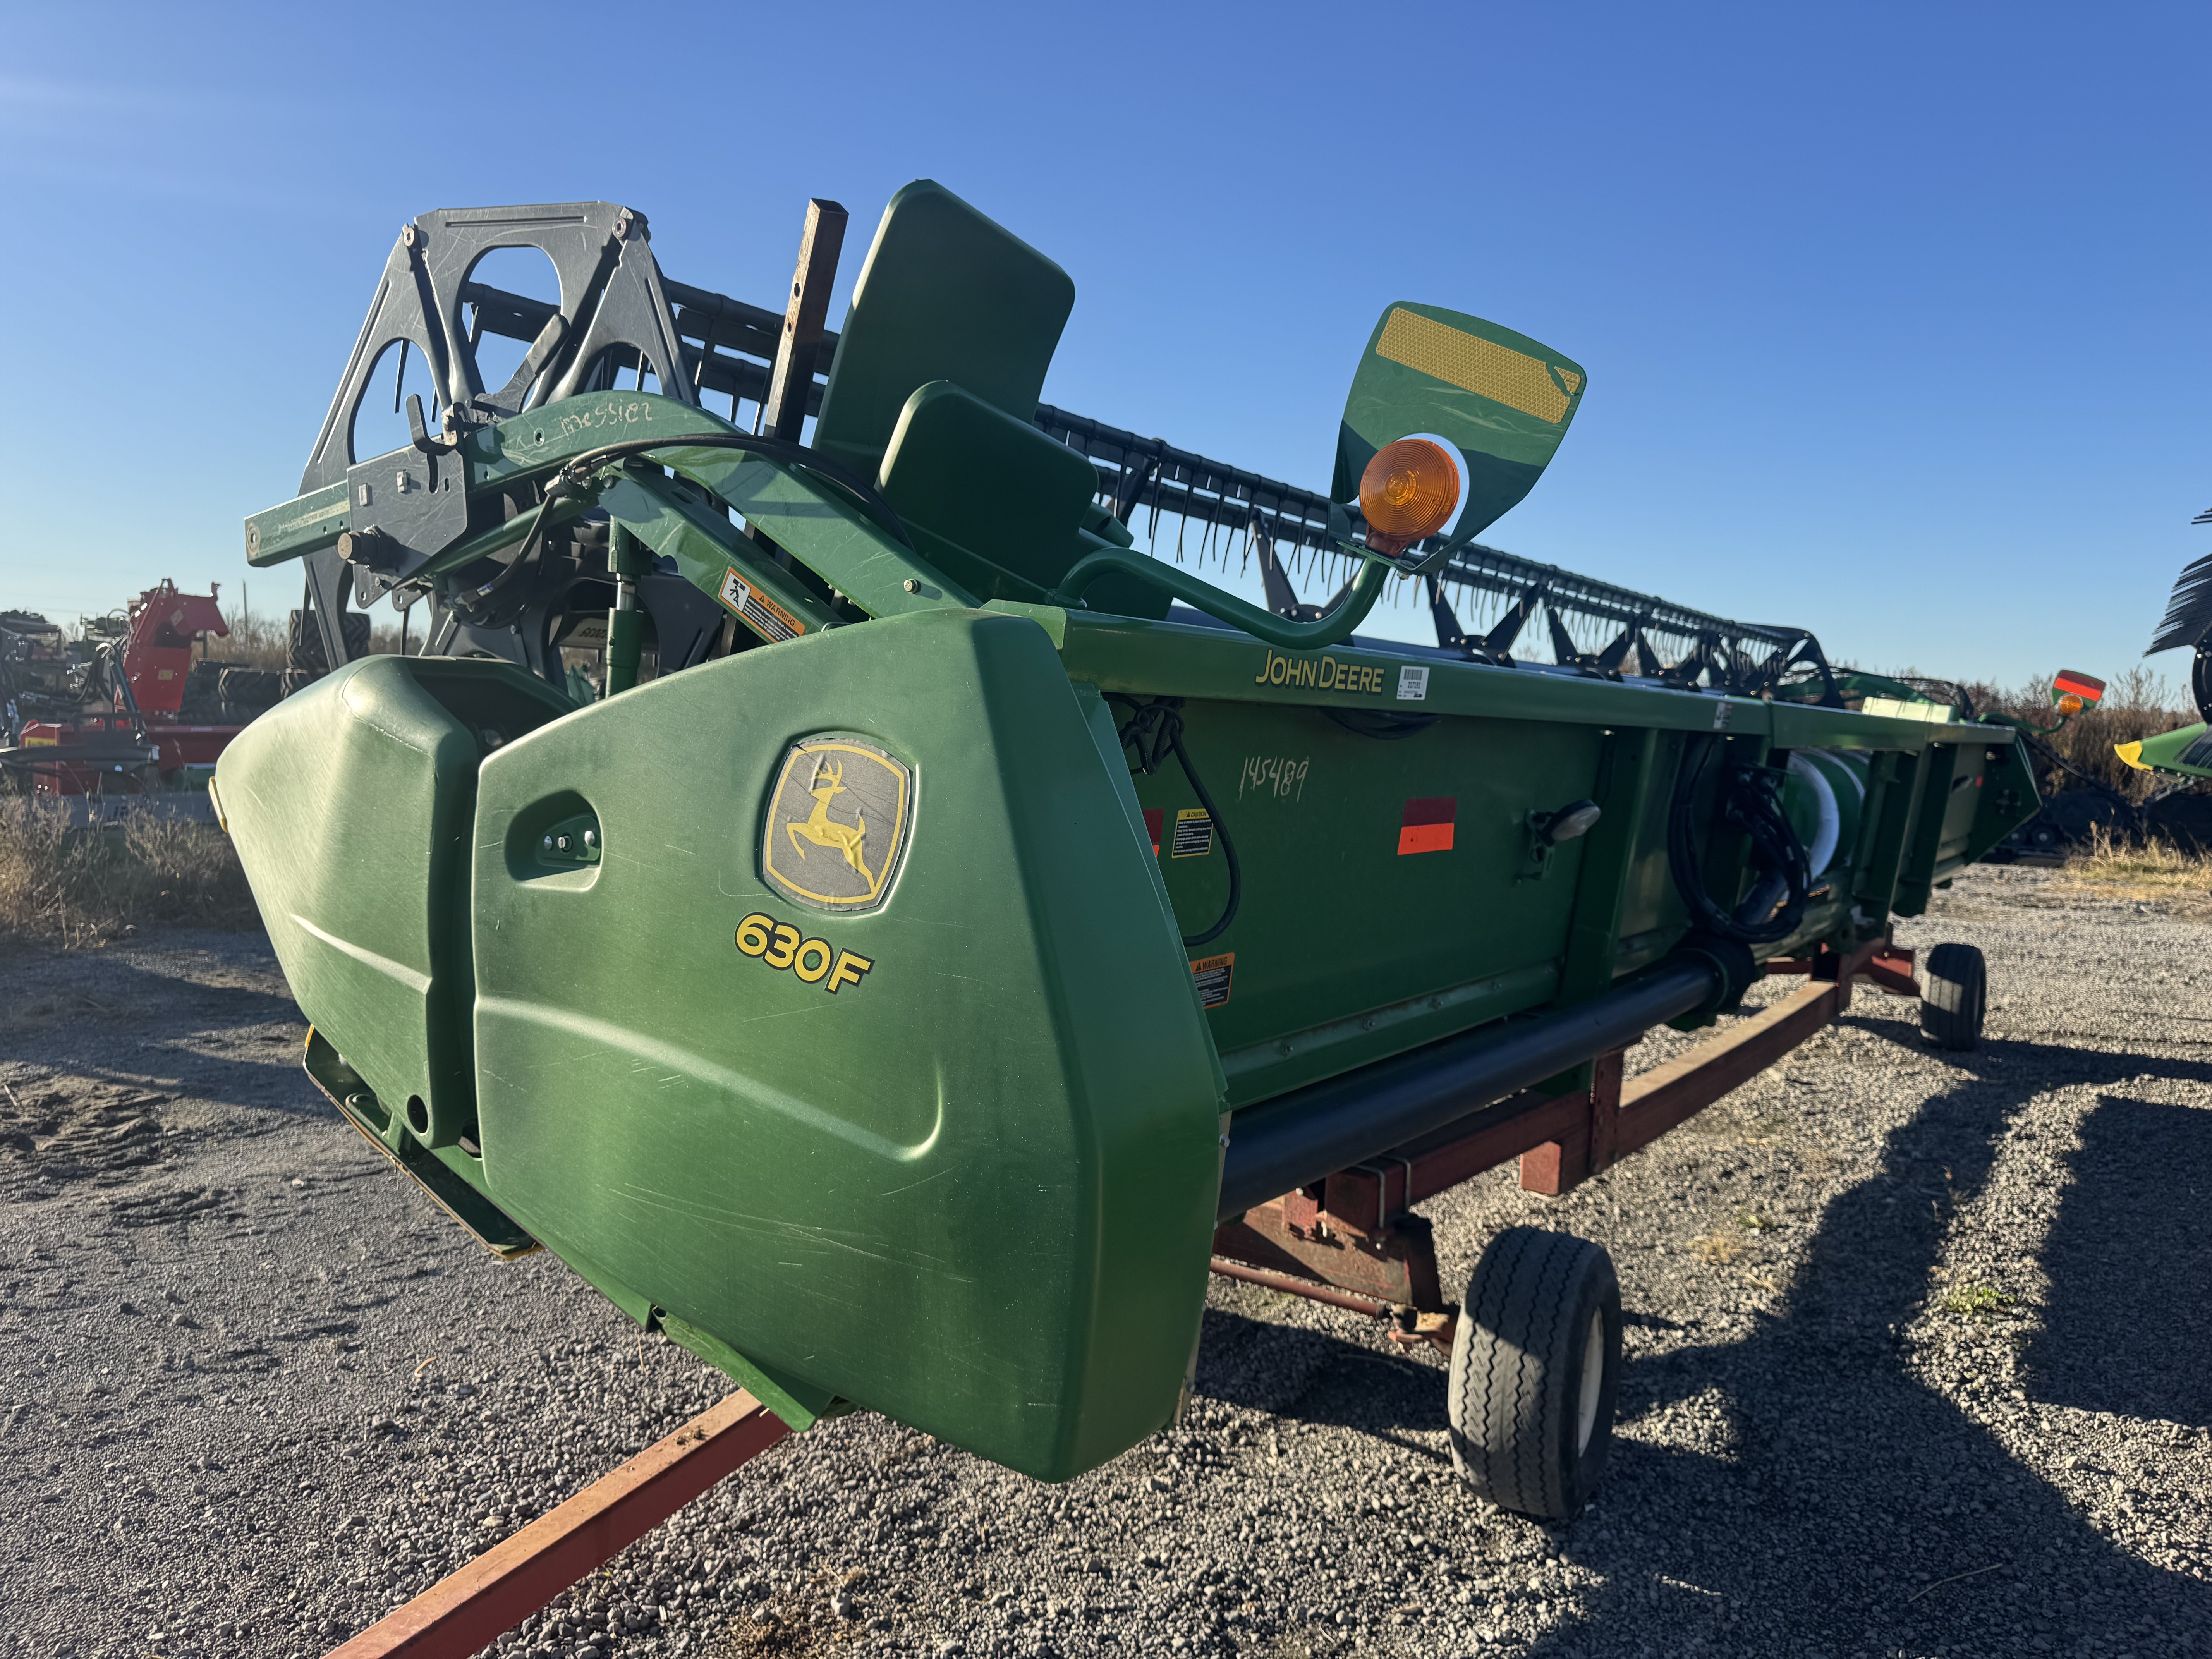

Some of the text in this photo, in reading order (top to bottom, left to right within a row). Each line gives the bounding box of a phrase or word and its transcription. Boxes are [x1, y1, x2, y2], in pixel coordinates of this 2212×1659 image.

[767, 600, 795, 627] WARNING
[1255, 649, 1384, 693] JOHN DEERE
[735, 912, 875, 994] 630F
[1202, 957, 1228, 970] WARNING
